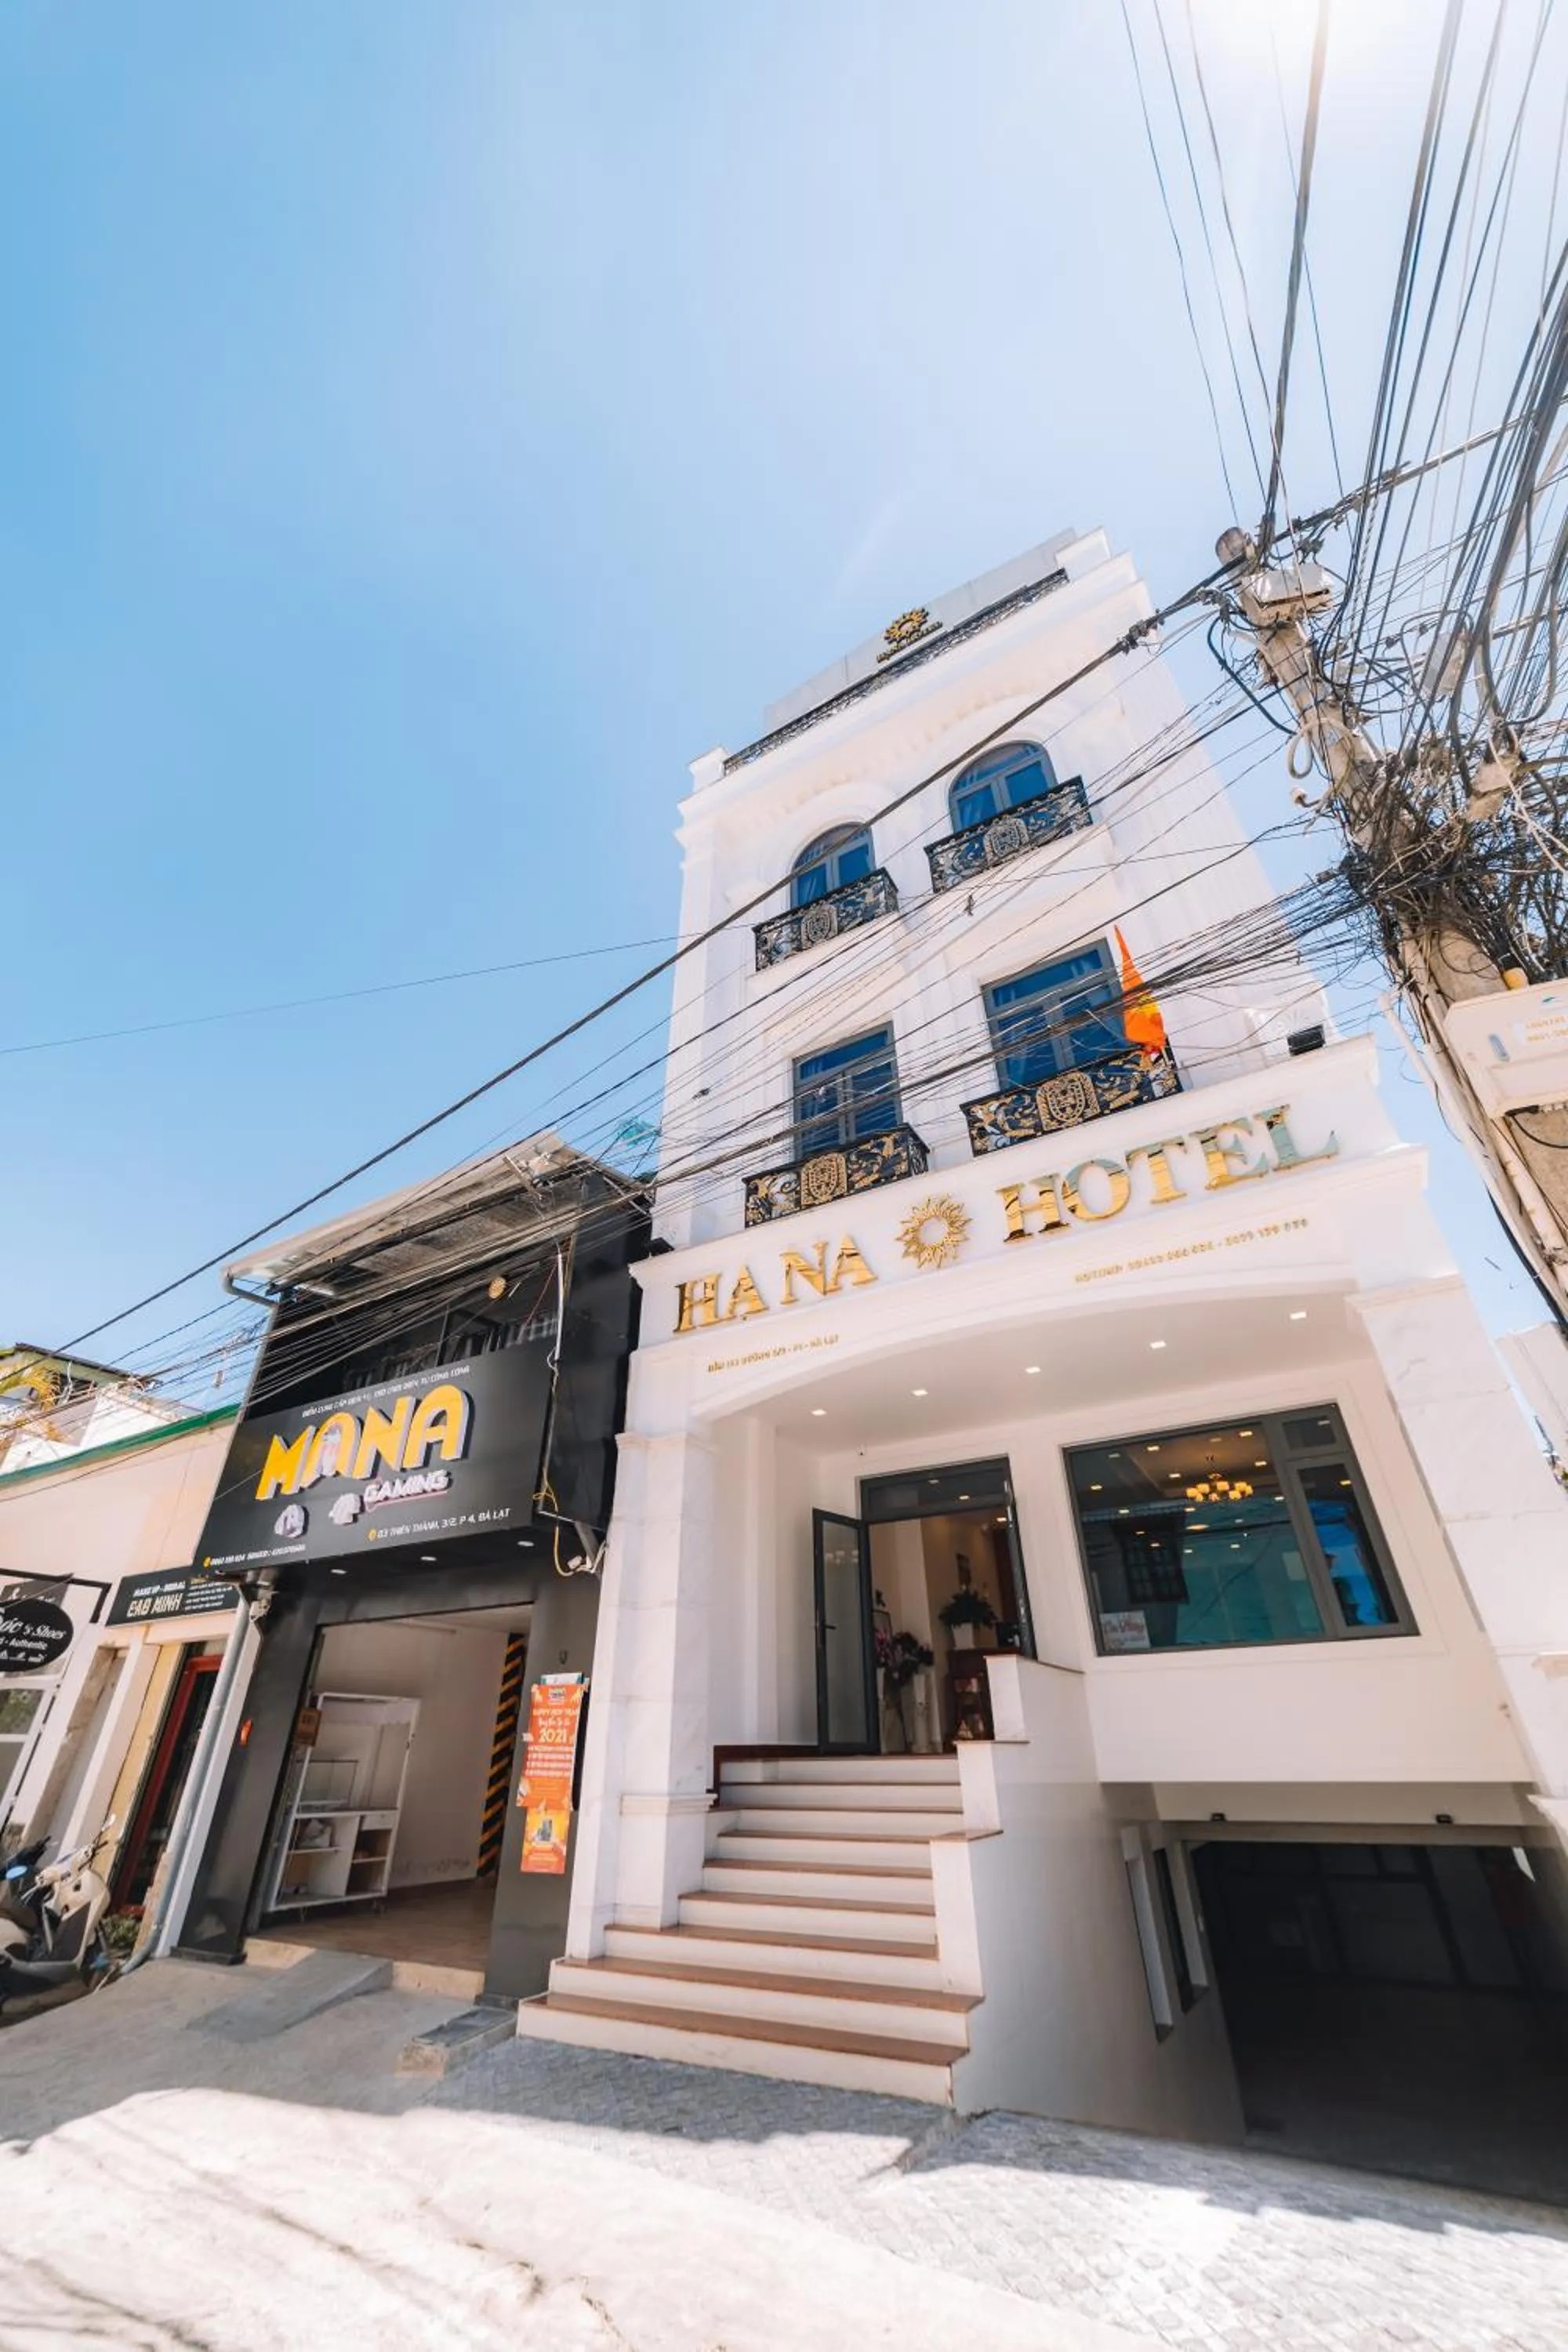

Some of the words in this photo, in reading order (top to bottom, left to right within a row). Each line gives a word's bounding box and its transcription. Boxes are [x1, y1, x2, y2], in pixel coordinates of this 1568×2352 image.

[995, 1104, 1339, 1243] HOTEL
[256, 1384, 469, 1501] MANA
[364, 1468, 450, 1504] GAMING
[539, 1727, 568, 1744] 2021
